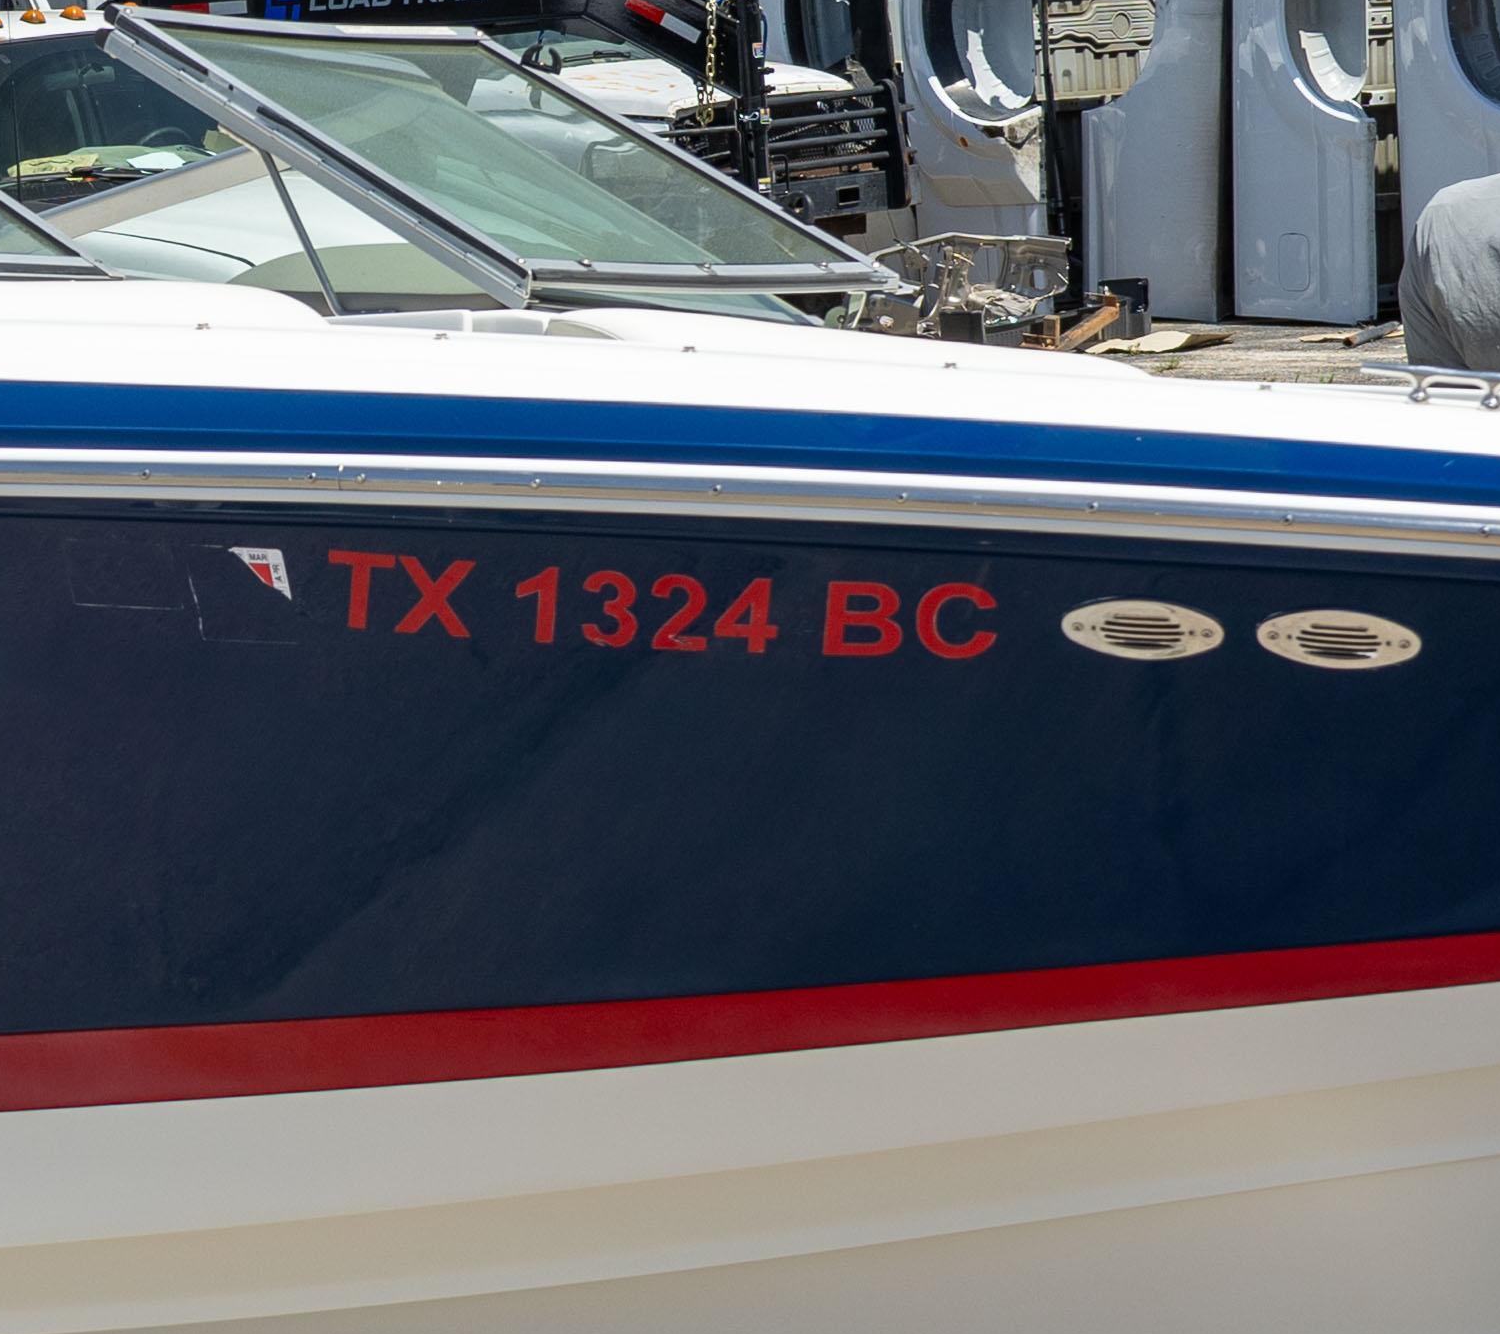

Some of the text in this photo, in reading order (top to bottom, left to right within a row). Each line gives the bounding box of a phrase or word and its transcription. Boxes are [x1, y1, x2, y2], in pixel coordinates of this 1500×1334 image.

[328, 549, 998, 659] TX 1324 BC
